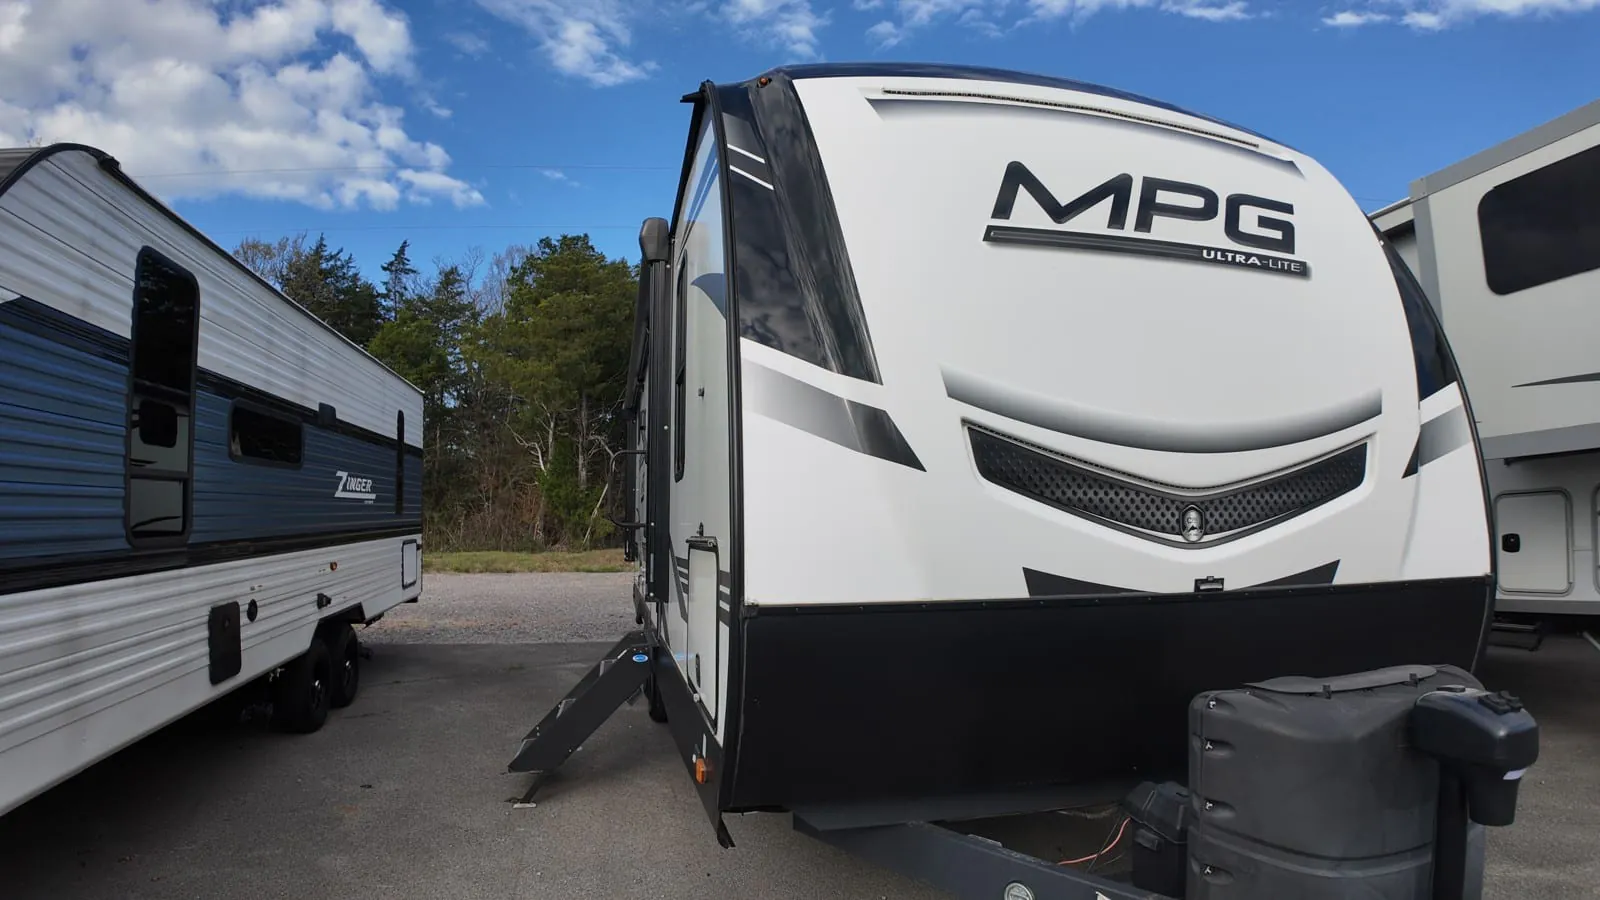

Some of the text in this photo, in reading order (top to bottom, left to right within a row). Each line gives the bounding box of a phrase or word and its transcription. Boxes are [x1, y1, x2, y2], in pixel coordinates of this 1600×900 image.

[991, 160, 1295, 254] MPG
[1202, 249, 1301, 273] ULTRA-LITE
[334, 470, 376, 499] ZINGER
